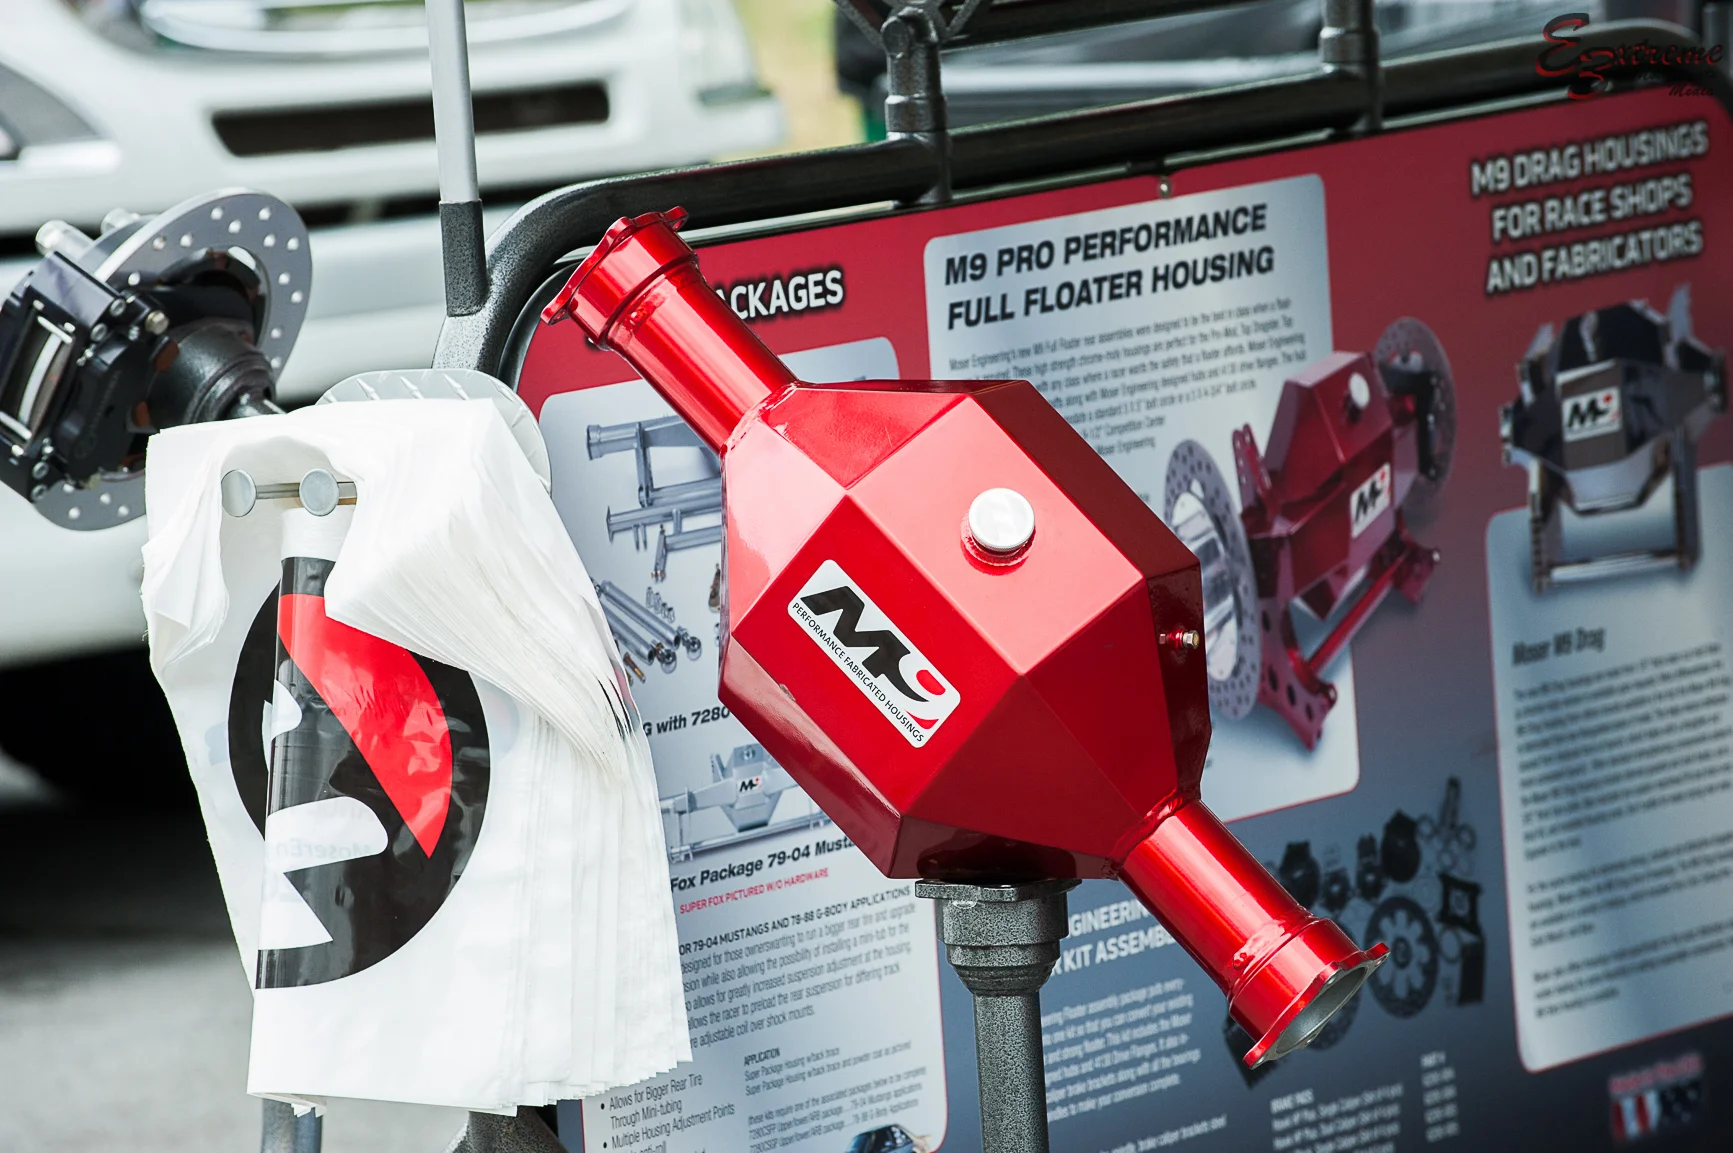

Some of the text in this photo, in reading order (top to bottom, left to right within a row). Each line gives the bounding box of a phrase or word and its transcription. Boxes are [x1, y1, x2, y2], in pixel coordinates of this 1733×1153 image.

[1471, 121, 1709, 195] M9 DRAG HOUSINGS
[1493, 173, 1693, 242] FOR RACE SHOPS
[945, 204, 1268, 285] M9 PRO PERFORMANCE
[1486, 221, 1704, 293] AND FABRICATORS
[948, 246, 1274, 330] FULL FLOATER HOUSING
[792, 603, 925, 742] PERFORMANCE FABRICATED HOUSINGS
[656, 713, 687, 734] with
[691, 706, 730, 727] 7280
[671, 874, 695, 892] Fox
[700, 857, 762, 887] Package
[767, 845, 809, 866] 79-04
[680, 867, 829, 914] SUPER FOX PICTURED W/O HARDWARE
[693, 936, 717, 951] 79-04
[720, 922, 768, 944] MUSTANGS
[771, 917, 788, 930] AND
[816, 902, 847, 917] G-BODY
[850, 886, 909, 909] APPLICATIONS
[712, 950, 721, 965] for
[724, 947, 742, 962] those
[825, 920, 843, 937] bigger
[693, 992, 714, 1009] allows
[716, 988, 725, 1002] for
[727, 982, 750, 1002] greatly
[753, 973, 784, 993] increased
[787, 963, 823, 985] suspension
[826, 953, 863, 975] adjustment
[872, 947, 882, 960] the
[701, 971, 719, 987] while
[721, 967, 734, 982] also
[737, 959, 764, 980] allowing
[766, 956, 776, 970] the
[779, 947, 810, 969] possibility
[822, 936, 850, 958] installing
[898, 921, 908, 934] the
[1064, 945, 1093, 973] KIT
[709, 1009, 720, 1023] the
[722, 1006, 739, 1019] racer
[742, 1002, 748, 1014] to
[750, 995, 775, 1014] preload
[777, 992, 787, 1005] the
[790, 989, 803, 1001] rear
[805, 978, 841, 998] suspension
[843, 974, 852, 986] for
[699, 1025, 733, 1047] adjustable
[736, 1022, 747, 1036] coil
[750, 1019, 763, 1031] over
[766, 1013, 785, 1027] shock
[744, 1046, 780, 1065] APPLICATION
[609, 1073, 703, 1111] Allows for Bigger Rear Tire
[610, 1098, 682, 1130] Through Mini-tubing
[611, 1103, 735, 1150] Multiple Housing Adjustment Points
